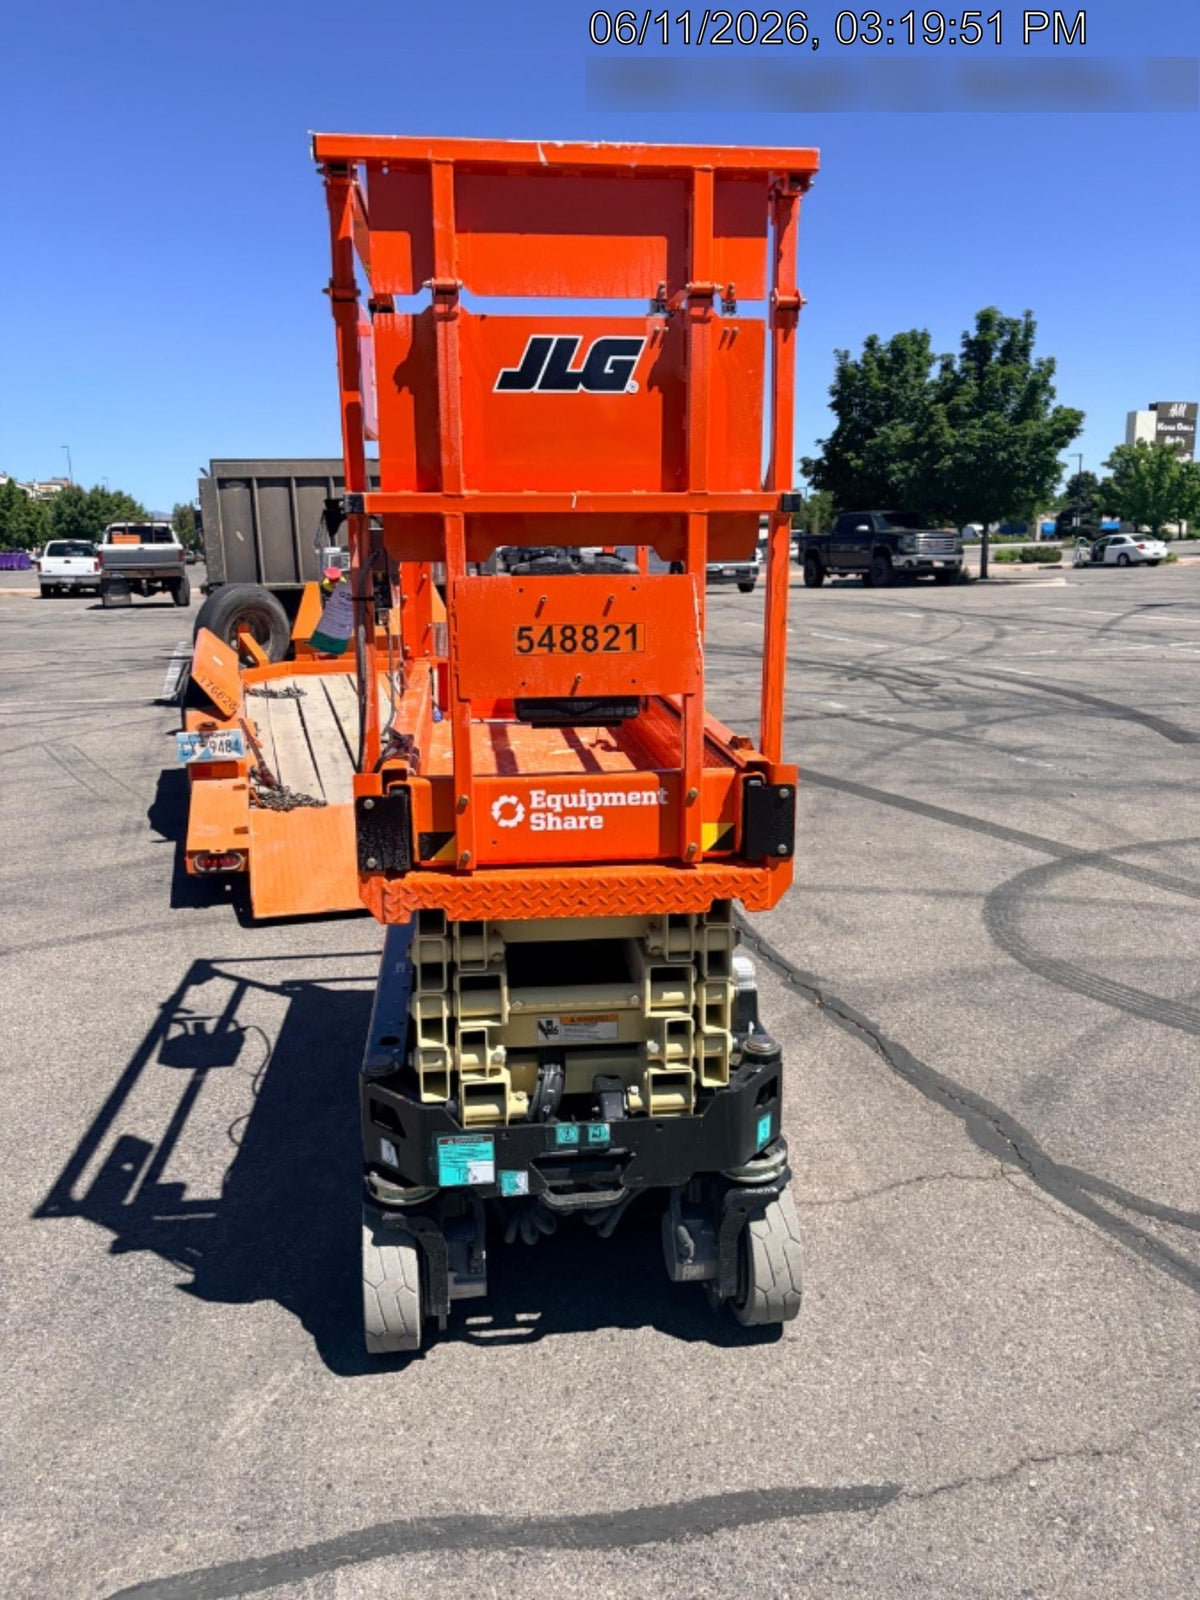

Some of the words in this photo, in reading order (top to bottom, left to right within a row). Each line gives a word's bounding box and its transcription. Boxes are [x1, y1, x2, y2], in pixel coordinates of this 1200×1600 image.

[492, 334, 648, 394] JLG
[516, 623, 638, 654] 548821
[529, 787, 669, 812] Equipment
[530, 811, 604, 831] Share
